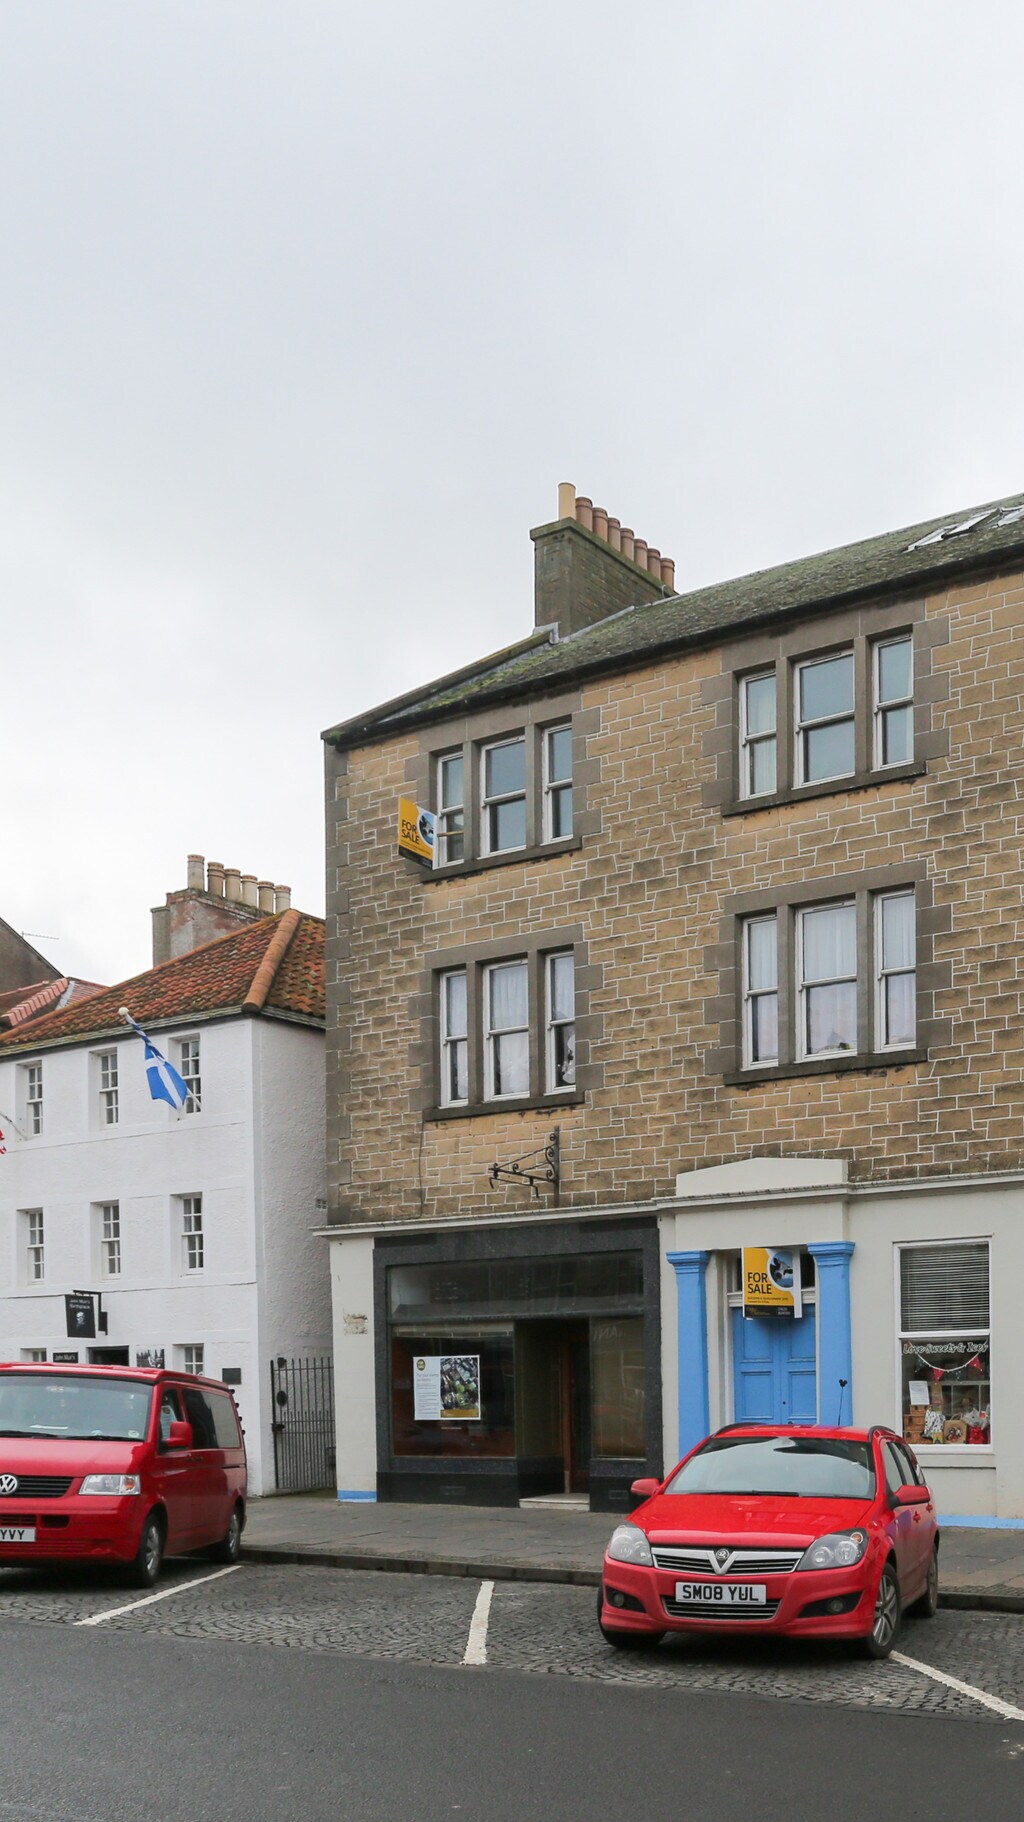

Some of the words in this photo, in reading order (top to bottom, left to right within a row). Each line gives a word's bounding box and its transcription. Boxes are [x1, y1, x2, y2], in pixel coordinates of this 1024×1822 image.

[401, 820, 417, 833] FOR
[401, 829, 420, 844] SALE
[747, 1272, 768, 1283] FOR
[747, 1283, 772, 1294] SALE
[903, 1344, 924, 1354] Love
[925, 1343, 956, 1354] Sweets
[682, 1585, 723, 1600] SM08
[728, 1586, 759, 1602] YUL
